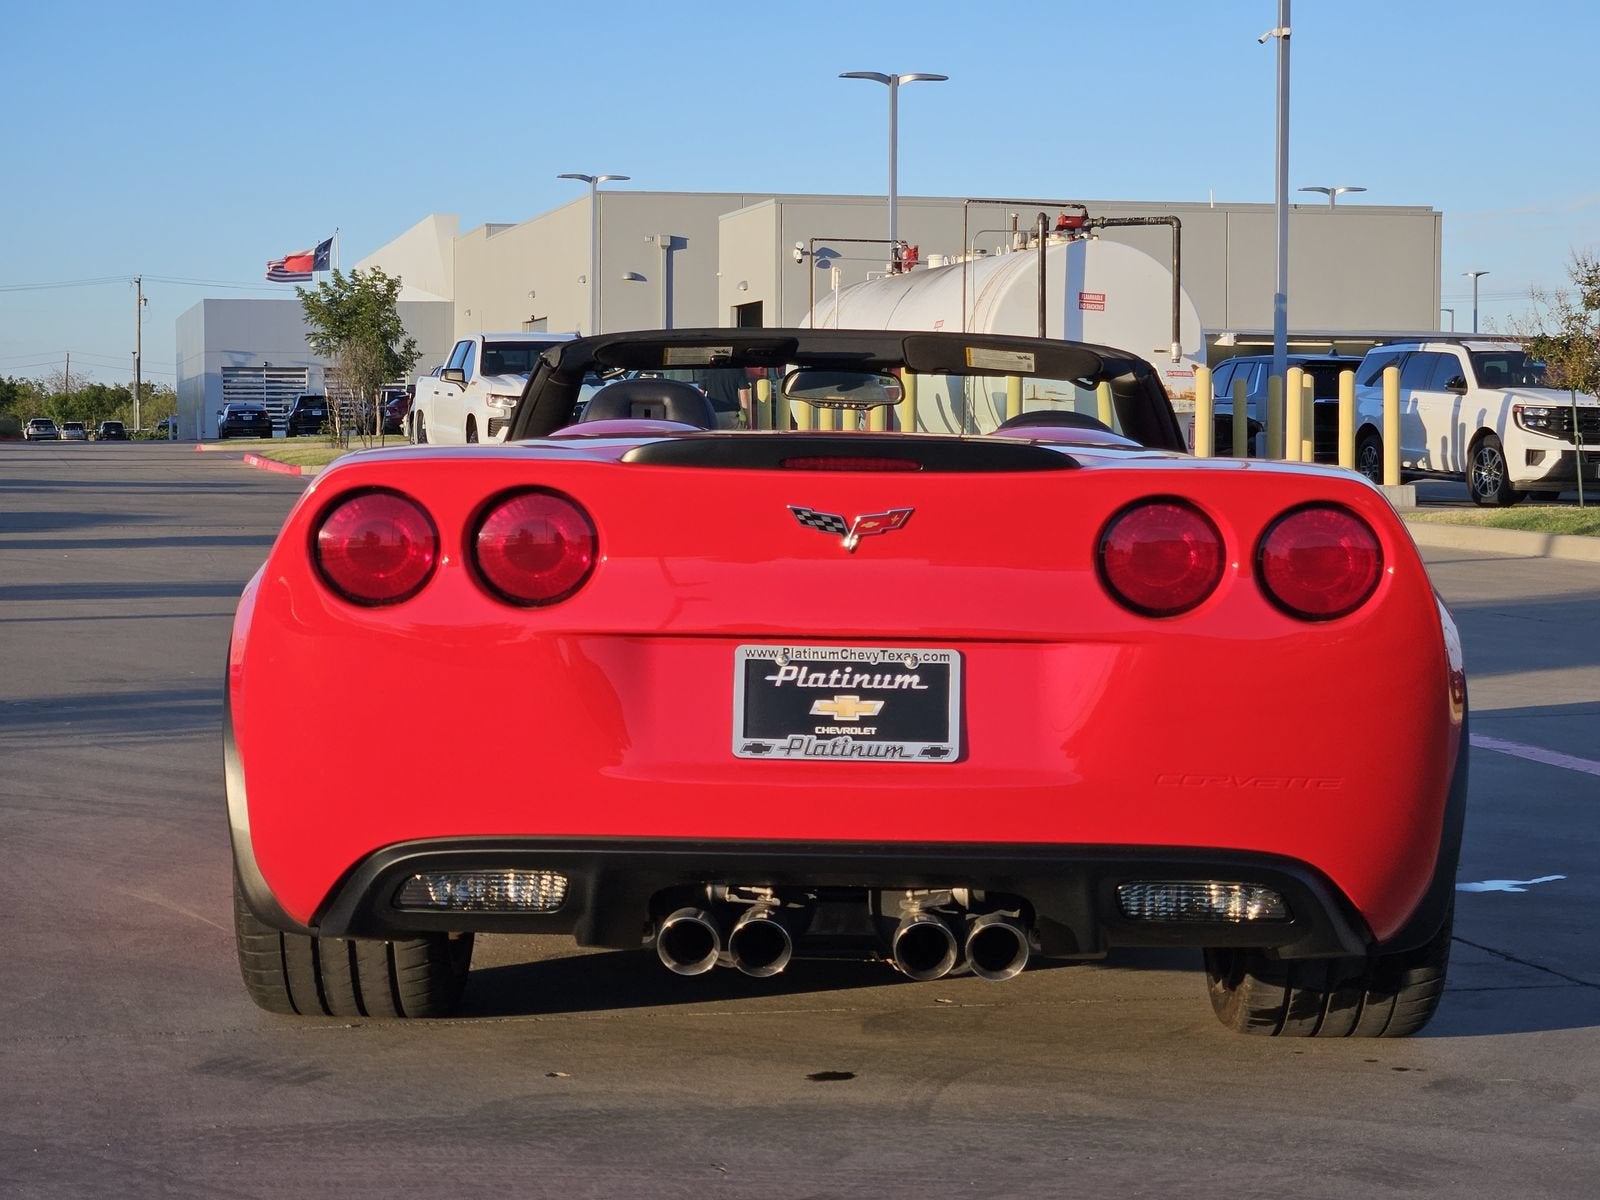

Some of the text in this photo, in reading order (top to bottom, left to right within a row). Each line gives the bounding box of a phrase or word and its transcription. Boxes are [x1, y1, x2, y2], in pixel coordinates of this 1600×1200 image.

[745, 648, 950, 663] wwwPlatinumChevyTexas.com
[764, 665, 928, 689] Platinum
[815, 726, 877, 735] CHEVROLET
[778, 738, 914, 759] Platinum
